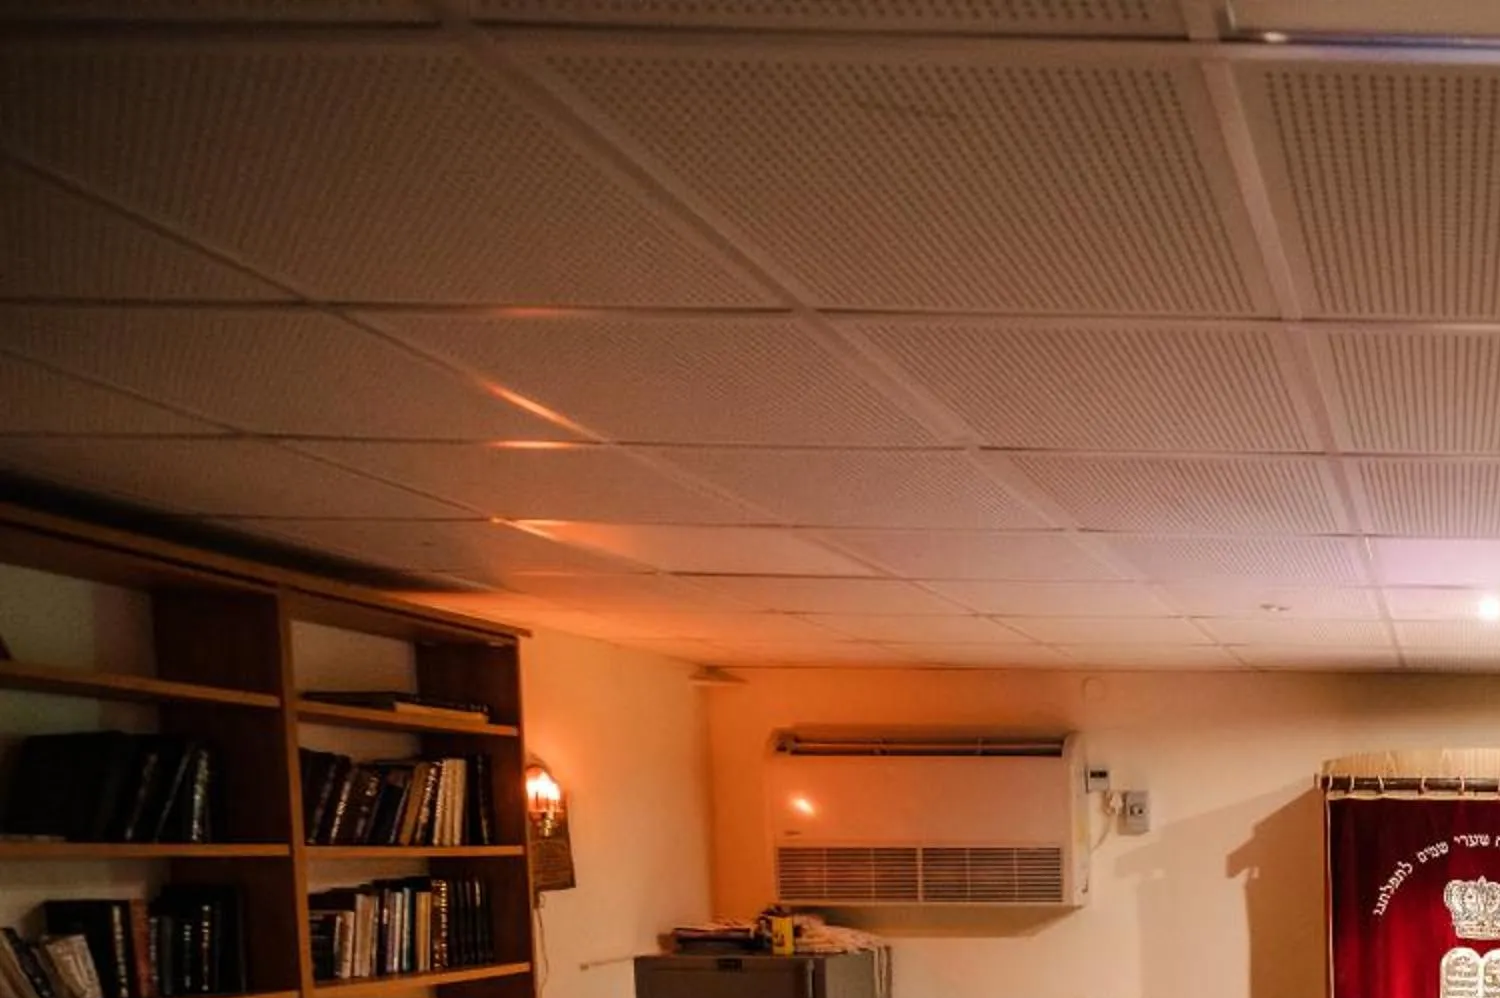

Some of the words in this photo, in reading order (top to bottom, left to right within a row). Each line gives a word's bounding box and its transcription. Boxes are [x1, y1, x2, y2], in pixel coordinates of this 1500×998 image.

[1453, 833, 1490, 848] שערי
[1416, 841, 1449, 864] שמים
[1372, 861, 1413, 916] לתפלתנו
